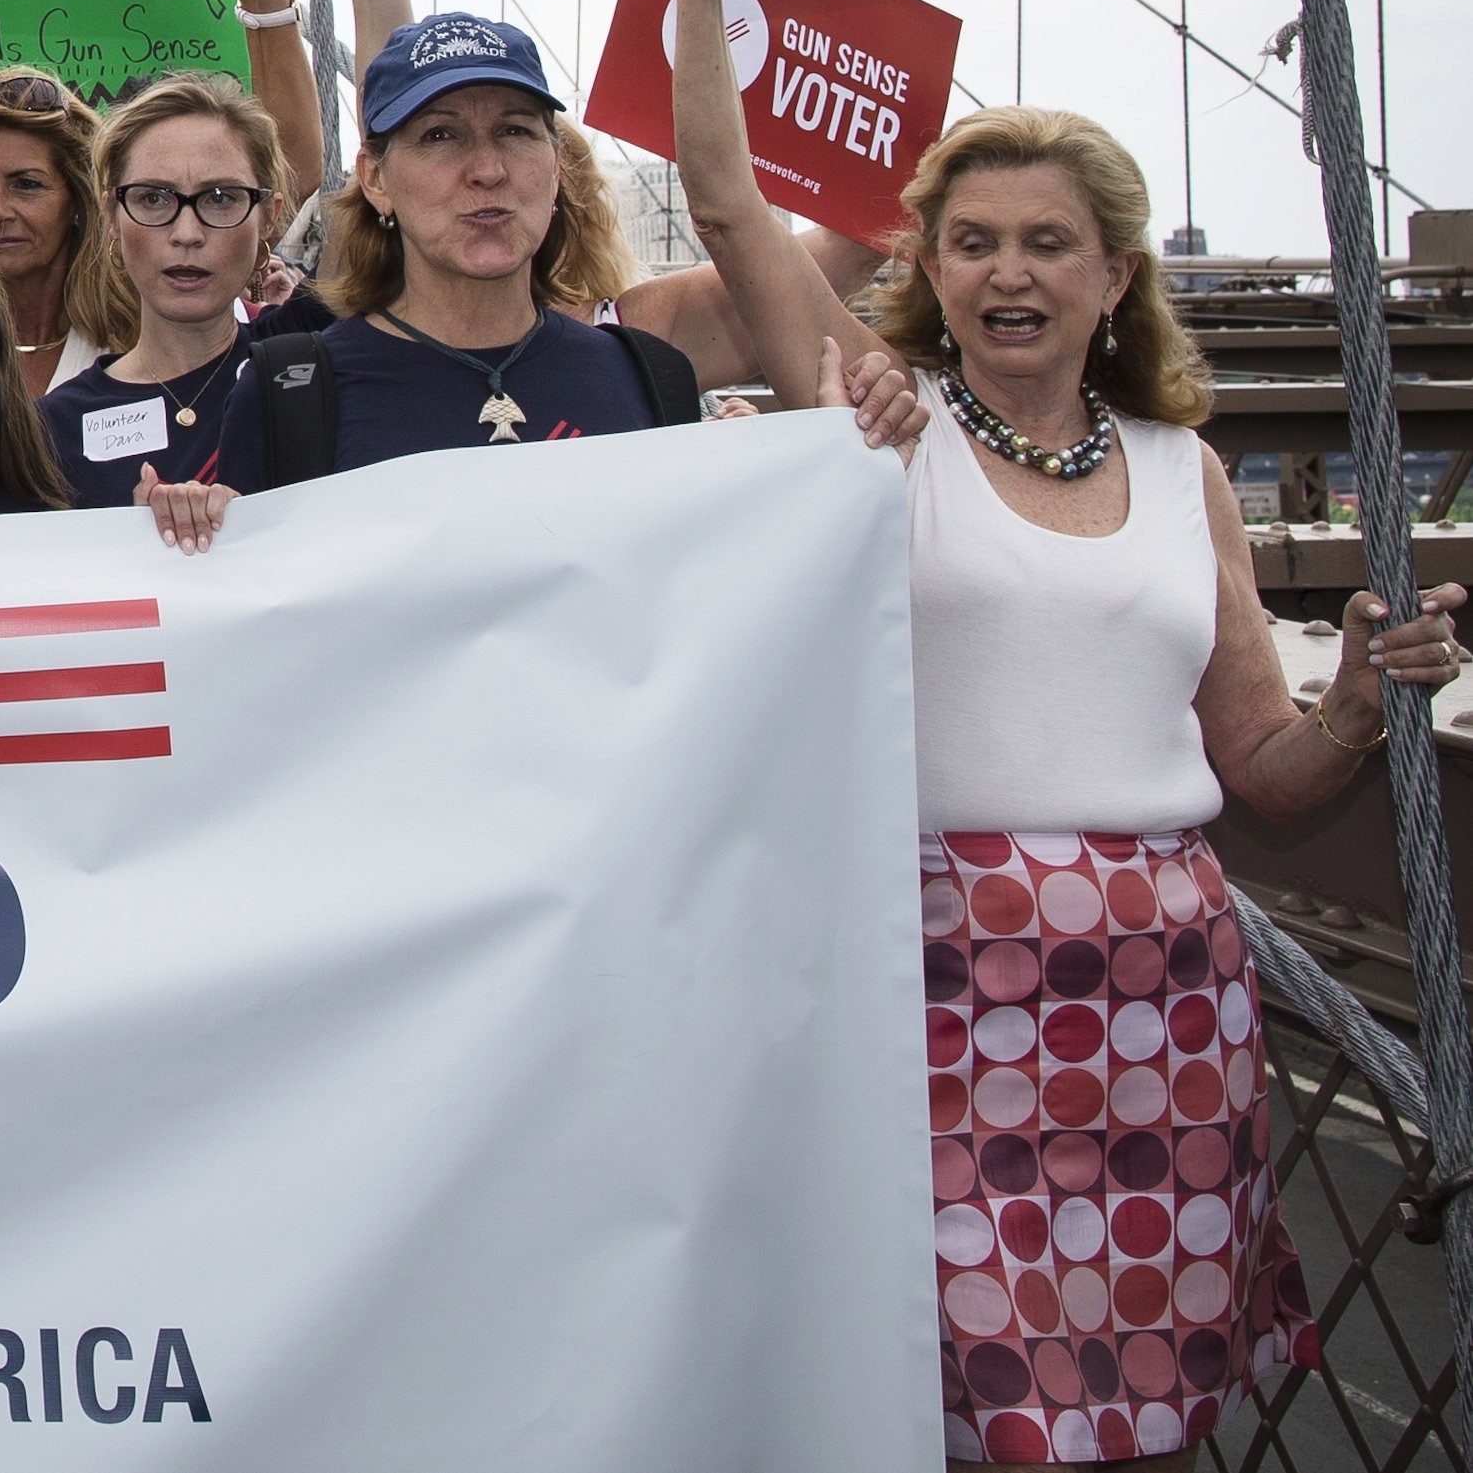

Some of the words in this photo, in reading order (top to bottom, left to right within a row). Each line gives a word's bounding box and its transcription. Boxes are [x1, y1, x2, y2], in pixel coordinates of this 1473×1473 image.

[38, 7, 103, 64] Gun
[121, 3, 222, 63] Sense
[413, 46, 507, 69] MONTEVERDE
[781, 17, 831, 60] GUN
[835, 43, 911, 104] SENSE
[771, 56, 902, 170] VOTER
[750, 153, 822, 196] sensevoter.org
[85, 409, 148, 433] Volunteer
